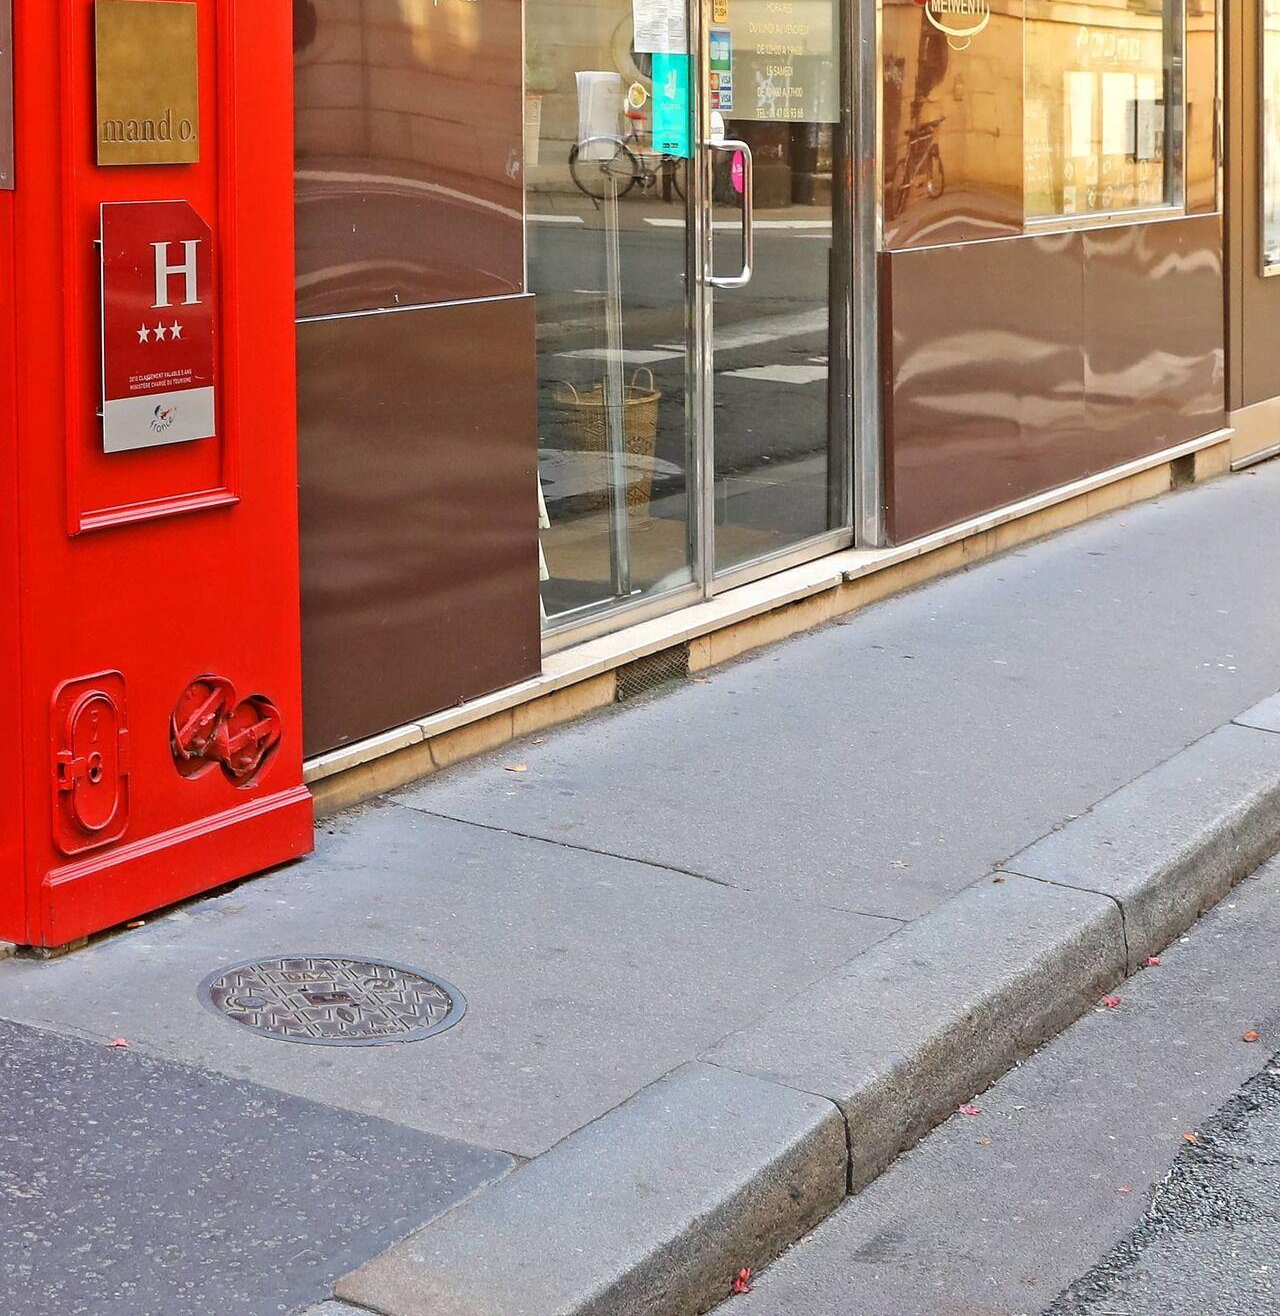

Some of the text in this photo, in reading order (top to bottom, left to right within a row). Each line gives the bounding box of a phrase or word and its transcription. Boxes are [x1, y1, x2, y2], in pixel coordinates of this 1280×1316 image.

[721, 75, 732, 85] VISA
[721, 92, 732, 104] VISA
[149, 239, 203, 309] H
